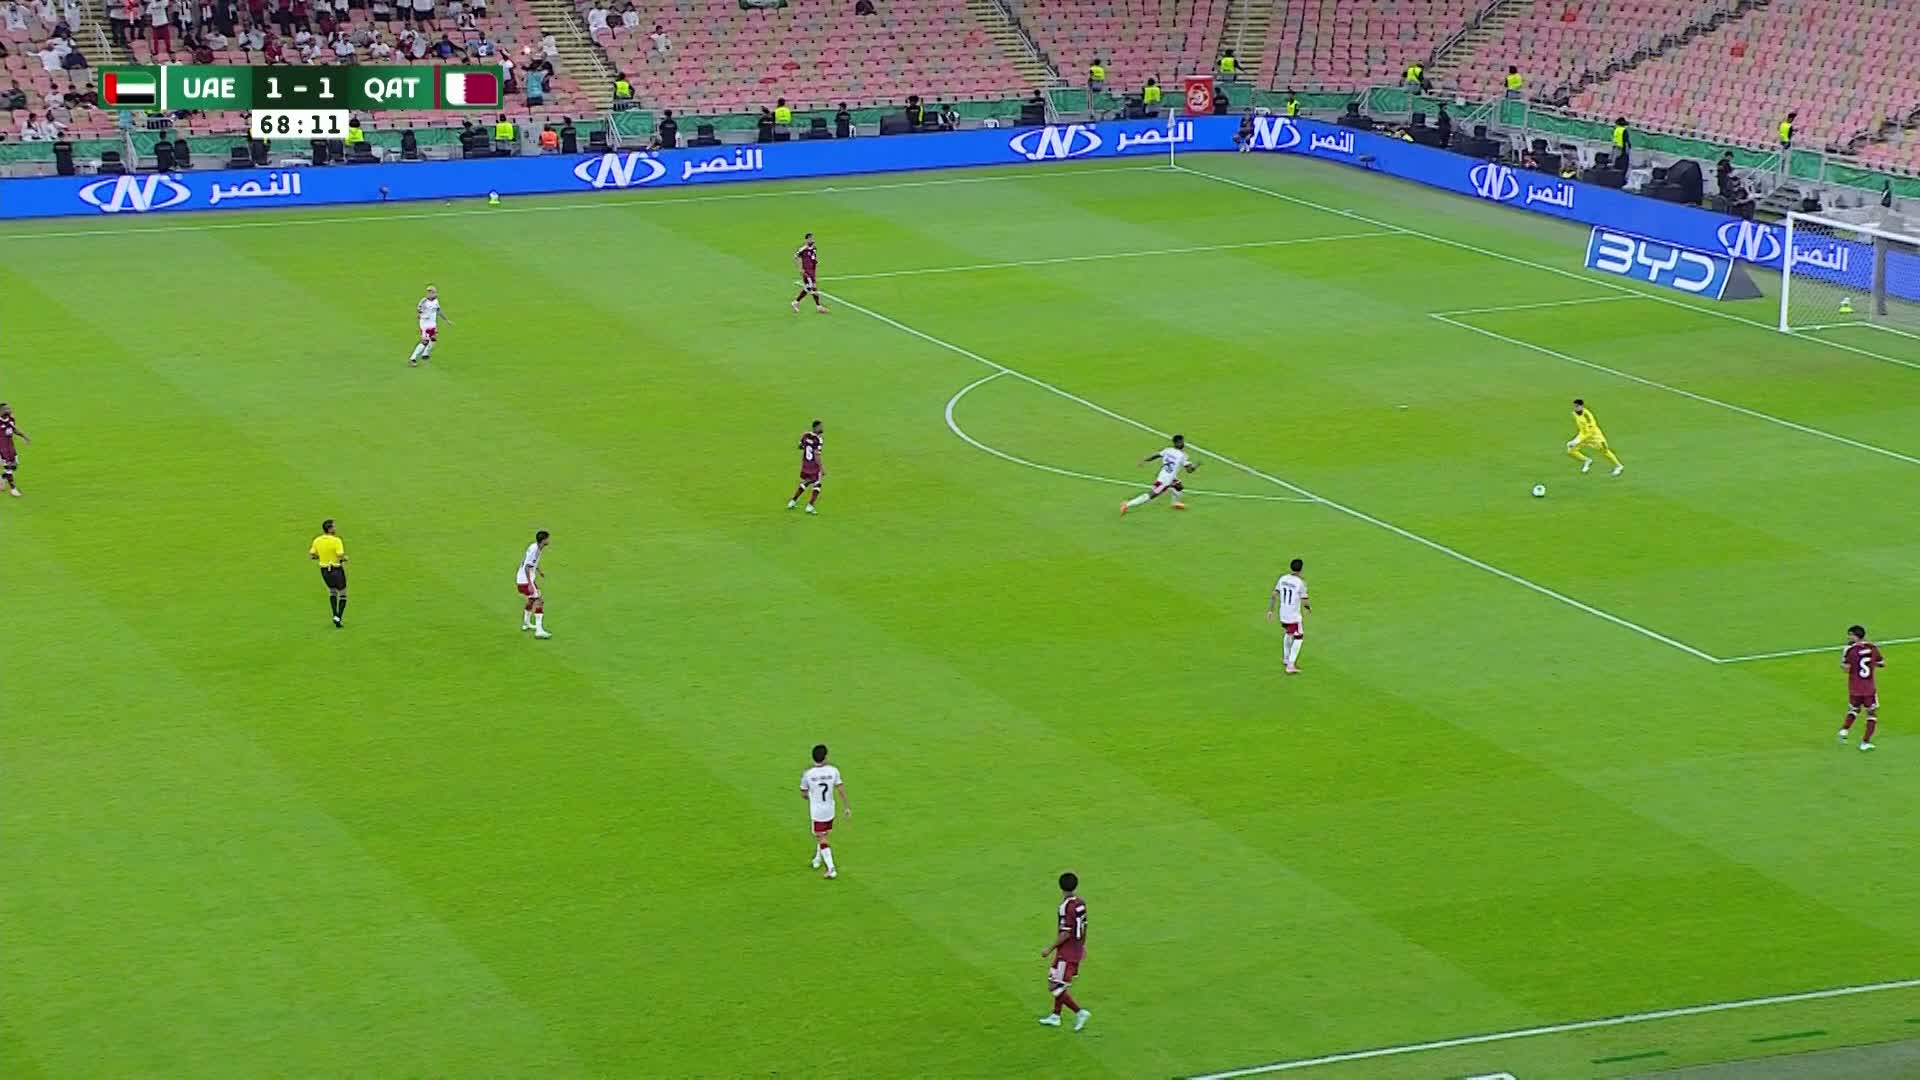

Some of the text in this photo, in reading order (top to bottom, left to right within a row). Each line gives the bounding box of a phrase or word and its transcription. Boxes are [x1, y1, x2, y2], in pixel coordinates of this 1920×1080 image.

[1310, 132, 1354, 154] النصر
[680, 149, 763, 181] النصر
[209, 173, 301, 205] النصر
[1526, 183, 1574, 208] النصر
[1596, 232, 1715, 292] BYD
[1791, 244, 1849, 272] النصر
[1283, 587, 1293, 605] 11
[1859, 656, 1871, 679] 5
[818, 782, 829, 802] 7
